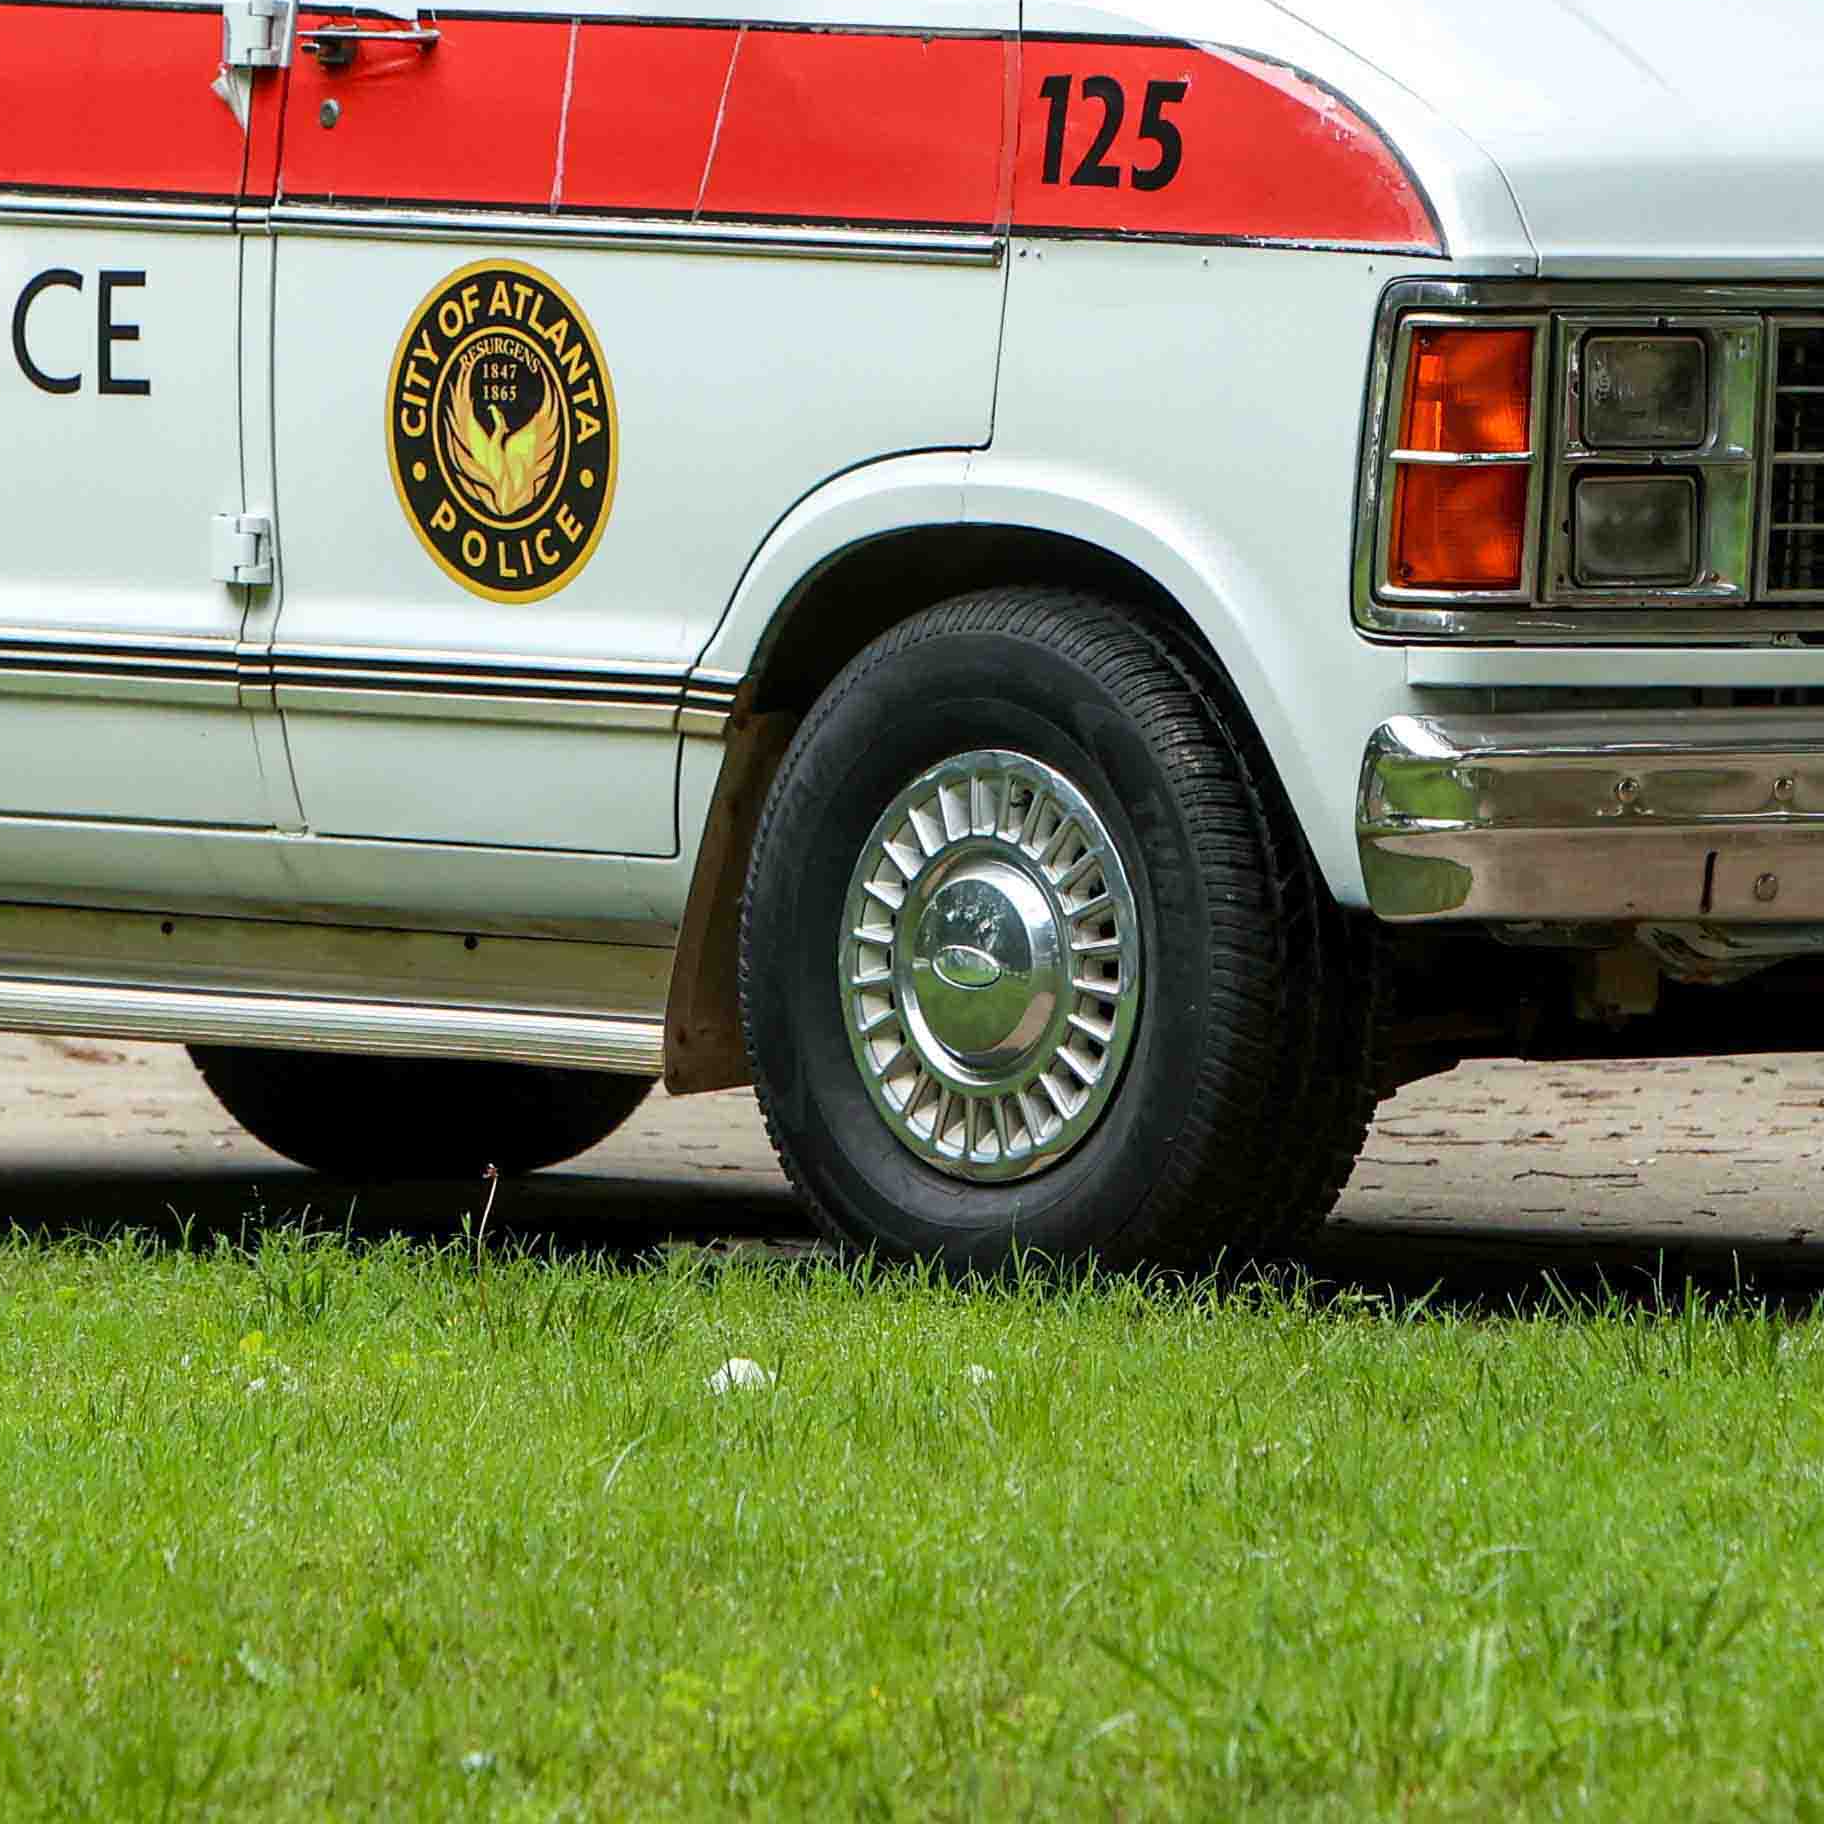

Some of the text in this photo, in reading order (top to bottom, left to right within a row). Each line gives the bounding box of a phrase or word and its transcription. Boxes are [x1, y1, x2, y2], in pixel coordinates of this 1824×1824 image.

[1039, 73, 1188, 192] 125
[400, 280, 601, 443] CITY OF ATLANTA
[458, 337, 541, 374] RESURGENS
[482, 363, 517, 380] 1847
[482, 384, 517, 401] 1865
[429, 498, 584, 578] POLICE
